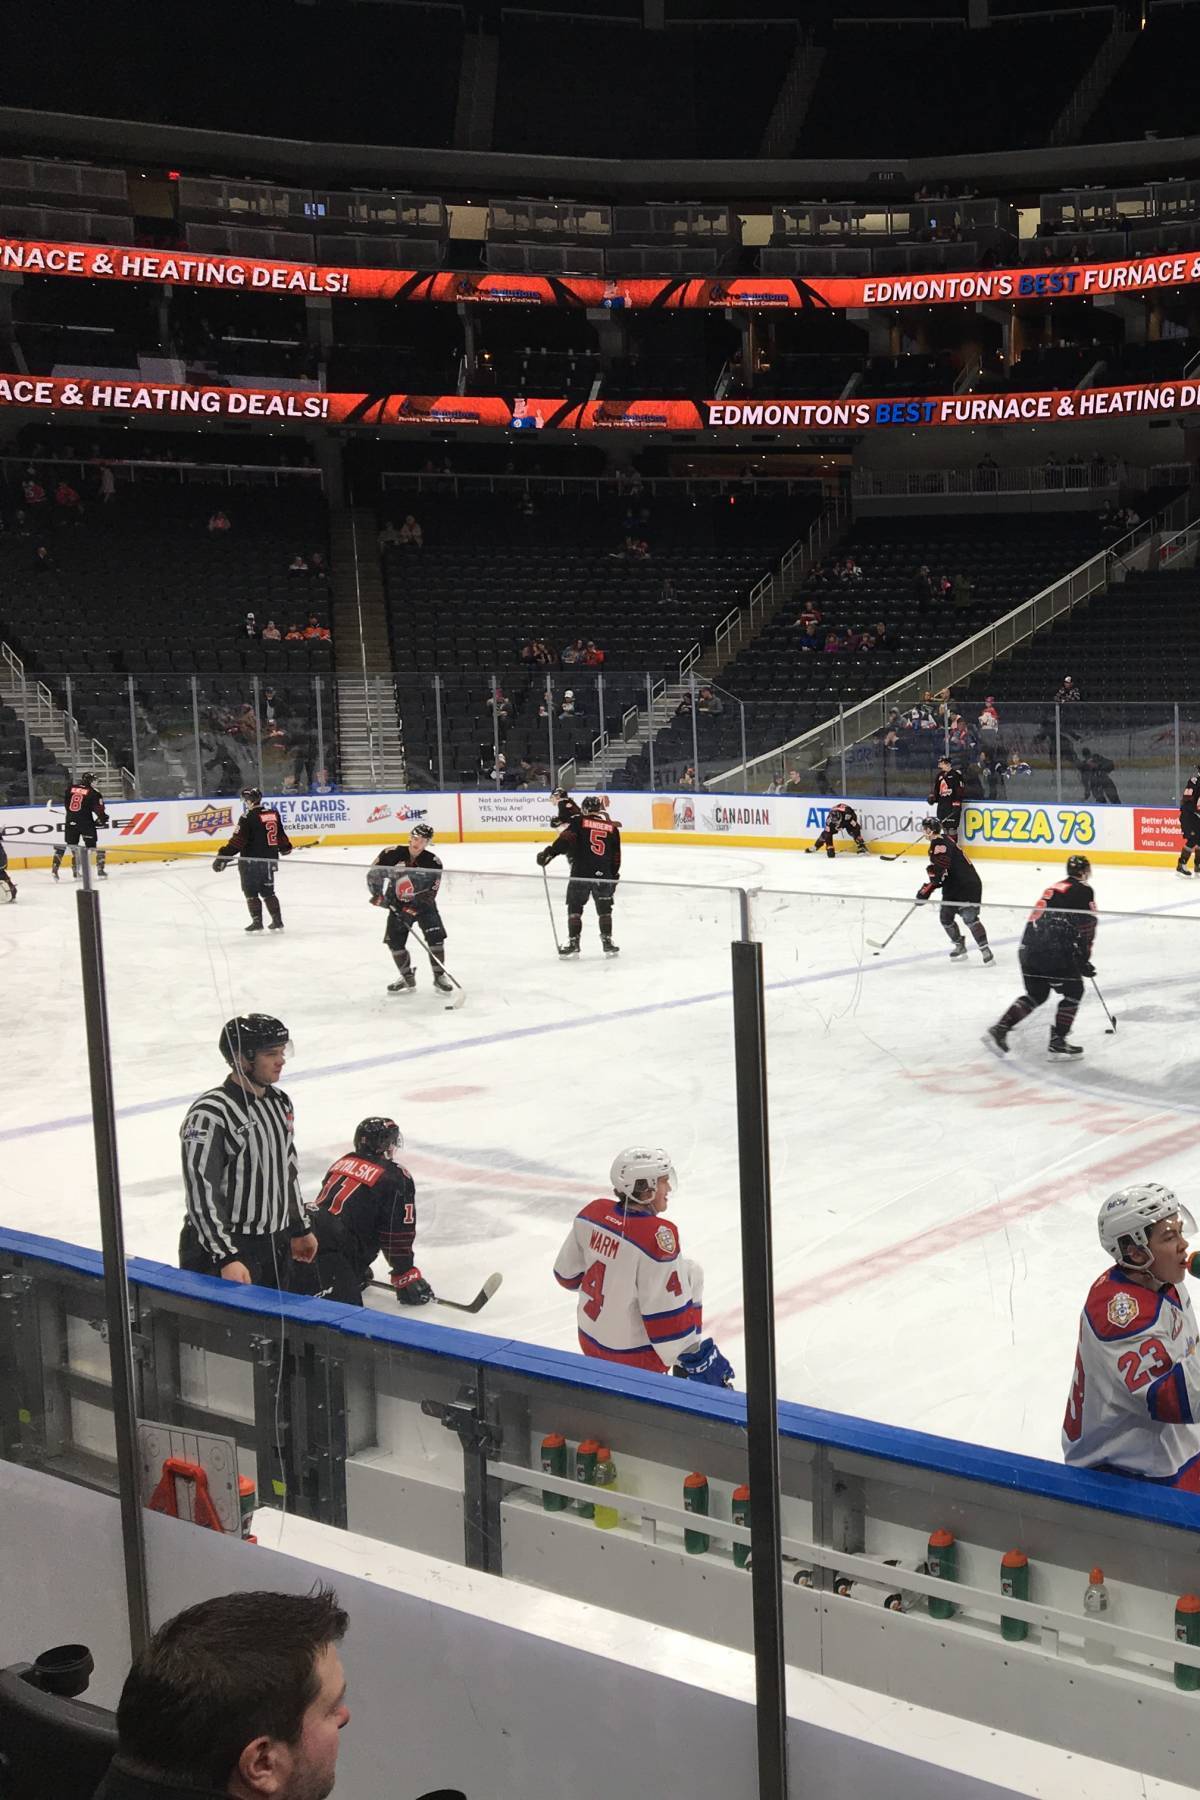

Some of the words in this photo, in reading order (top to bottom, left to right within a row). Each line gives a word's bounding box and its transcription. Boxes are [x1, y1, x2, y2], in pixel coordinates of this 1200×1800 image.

[0, 247, 84, 272] NACE
[92, 254, 114, 274] &
[121, 255, 245, 285] HEATING
[252, 268, 349, 293] DEALS!
[863, 276, 1013, 304] EDMONTON'S
[1019, 272, 1080, 296] BEST
[1084, 259, 1187, 291] FURNACE
[60, 384, 84, 406] &
[92, 386, 220, 413] HEATING
[228, 393, 328, 418] DEALS!
[708, 404, 870, 425] EDMONTON'S
[875, 402, 935, 423] BEST
[941, 397, 1052, 421] FURNACE
[1056, 396, 1075, 418] &
[1080, 385, 1175, 415] HEATING
[69, 795, 82, 812] 8
[188, 806, 232, 822] UPPER
[301, 799, 351, 812] CARDS.
[715, 807, 770, 826] CANADIAN
[964, 808, 1054, 844] PIZZA
[1057, 809, 1096, 844] 73
[1141, 816, 1162, 825] Better
[266, 822, 278, 846] 2
[1141, 825, 1154, 834] Join
[590, 830, 607, 855] 5
[1141, 839, 1155, 847] Visit
[605, 1215, 622, 1226] CCM
[589, 1229, 620, 1260] WARM
[581, 1260, 607, 1322] 4
[665, 1270, 683, 1297] 4
[1117, 1337, 1173, 1393] 23
